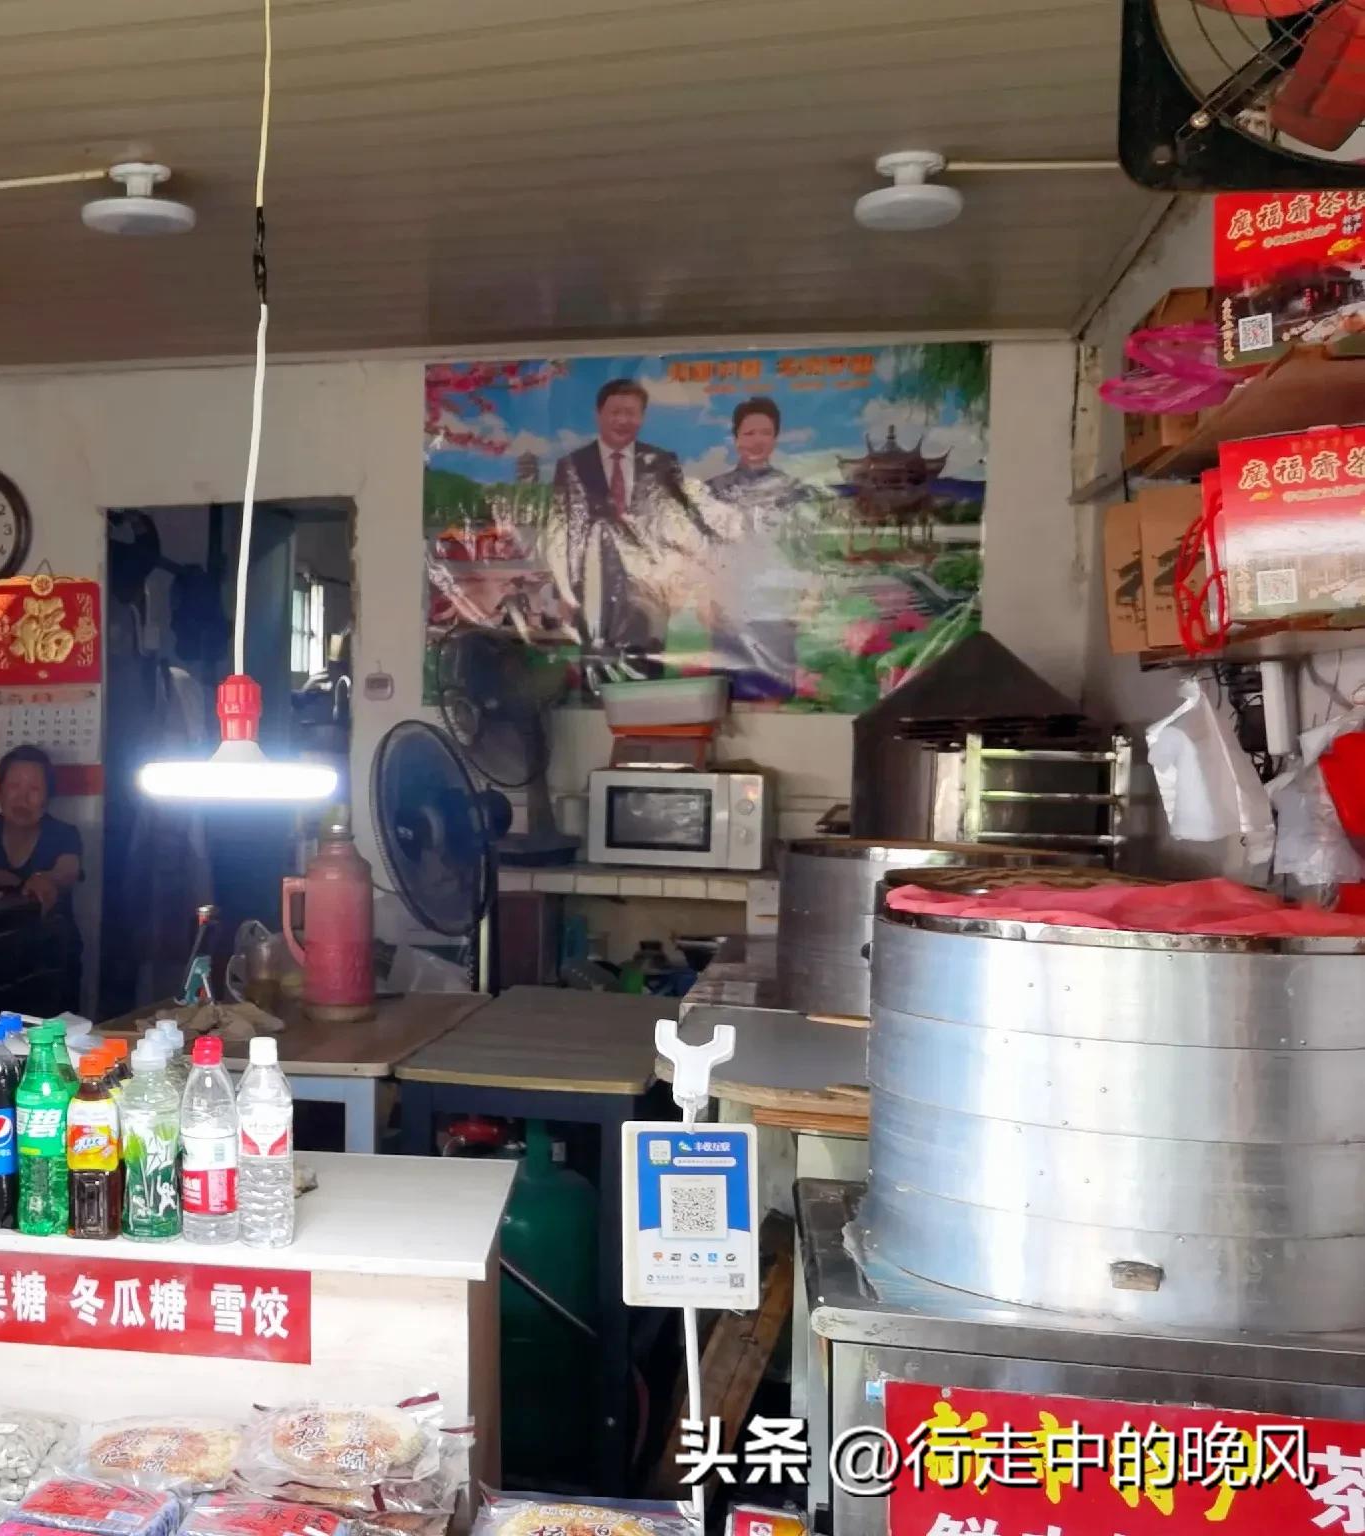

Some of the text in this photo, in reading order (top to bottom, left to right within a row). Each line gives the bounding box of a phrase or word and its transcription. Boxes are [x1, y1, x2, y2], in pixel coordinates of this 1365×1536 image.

[69, 1274, 187, 1332] 冬瓜糖
[210, 1283, 290, 1339] 雪饺
